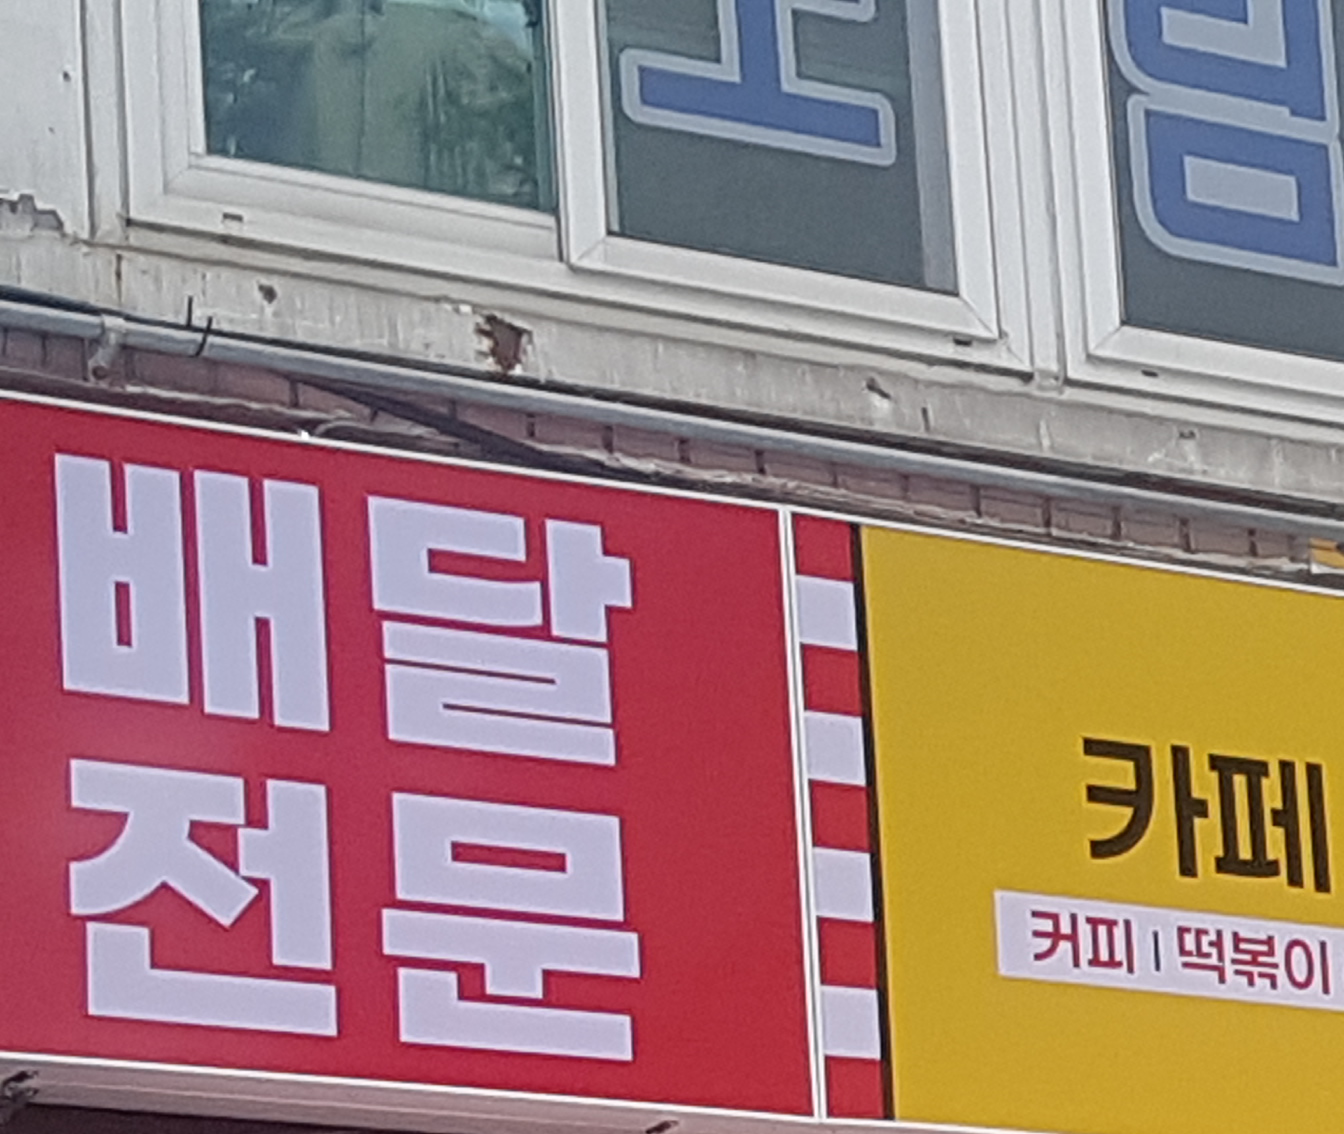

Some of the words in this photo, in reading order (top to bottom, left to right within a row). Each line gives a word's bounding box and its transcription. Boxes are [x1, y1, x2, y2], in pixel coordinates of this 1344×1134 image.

[54, 452, 633, 767] 배달
[69, 758, 641, 1062] 전문
[1030, 909, 1135, 974] 커피
[1176, 925, 1331, 995] 떡볶이
